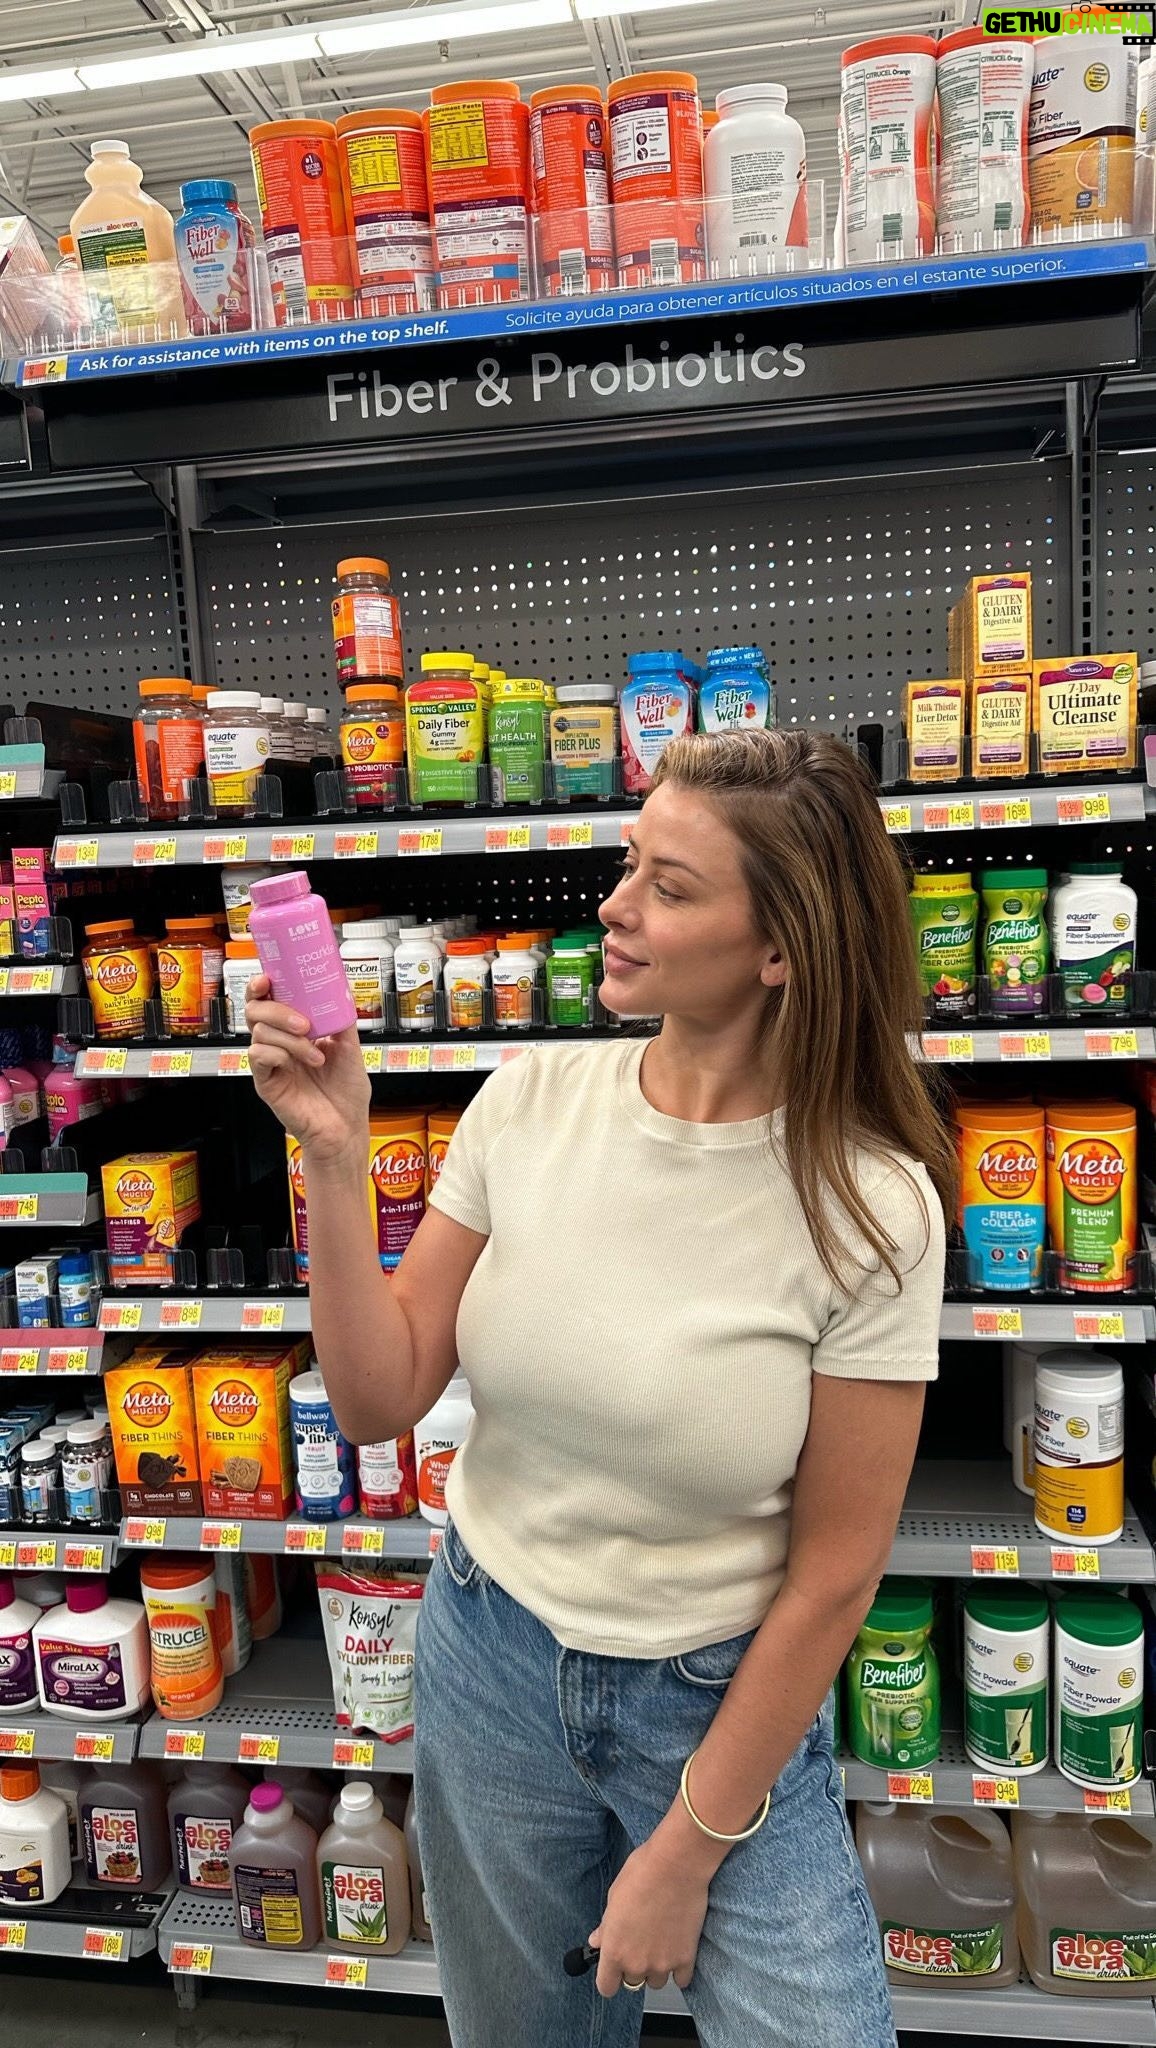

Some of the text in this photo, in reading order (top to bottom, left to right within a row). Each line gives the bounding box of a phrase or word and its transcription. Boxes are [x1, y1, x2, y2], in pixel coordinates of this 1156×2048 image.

[1039, 111, 1063, 124] Fiber
[106, 222, 122, 231] aloe
[121, 220, 138, 229] vera
[185, 224, 221, 246] Fiber
[187, 238, 215, 261] Well
[505, 256, 1067, 328] Solicite ayuda para obtener artículos situados en el estante superior.
[79, 319, 450, 371] Ask for assistance with items on the top shelf.
[327, 332, 807, 422] Fiber & Probiotics
[983, 594, 1023, 606] GLUTEN
[982, 605, 1022, 617] & DAIRY
[983, 616, 1023, 627] Digestive Aid
[1068, 682, 1101, 694] 7-Day
[635, 692, 673, 712] Fiber
[714, 689, 752, 709] Fiber
[981, 697, 1022, 708] GLUTEN
[1048, 692, 1122, 710] Ultimate
[448, 703, 475, 711] VALLEY
[714, 703, 743, 722] Well
[917, 702, 958, 712] Milk Thistle
[636, 707, 665, 725] Well
[916, 713, 957, 723] Liver Detox
[981, 708, 1022, 720] & DAIRY
[1052, 710, 1117, 726] Cleanse
[418, 718, 470, 731] Daily Fiber
[981, 719, 1009, 728] Digestive
[208, 733, 236, 743] equate
[431, 730, 456, 738] Gummy
[500, 732, 537, 741] HEALTH
[554, 738, 601, 751] FIBER PLUS
[14, 856, 39, 867] Pepto
[17, 895, 44, 905] Pepto
[1066, 913, 1098, 922] equate
[288, 920, 319, 937] LOVE
[987, 921, 1040, 945] Benefiber
[922, 927, 973, 950] Benefiber
[1084, 931, 1126, 940] Supplement
[296, 944, 335, 966] sparkle
[95, 963, 138, 980] Meta
[299, 963, 328, 978] fiber
[104, 976, 132, 986] MUCIL
[104, 997, 142, 1009] DAILY FIBER
[368, 1154, 426, 1175] Meta
[976, 1152, 1039, 1172] Meta
[1057, 1151, 1127, 1175] Meta
[381, 1174, 420, 1185] MUCIL
[988, 1173, 1030, 1183] MUCIL
[1069, 1176, 1115, 1187] MUCIL
[115, 1179, 156, 1192] Meta
[381, 1200, 423, 1214] 4-in-1 FIBER
[1071, 1207, 1114, 1217] PREMIUM
[989, 1210, 1020, 1219] FIBER
[1077, 1216, 1109, 1226] BLEND
[981, 1217, 1037, 1228] COLLAGEN
[122, 1392, 173, 1408] Meta
[209, 1391, 260, 1407] Meta
[131, 1407, 163, 1415] MUCIL
[219, 1406, 250, 1415] MUCIL
[297, 1412, 330, 1420] bellway
[294, 1422, 328, 1434] super
[120, 1431, 184, 1442] FIBER THINS
[206, 1431, 269, 1442] FIBER THINS
[309, 1431, 340, 1444] fiber
[1045, 1435, 1065, 1448] Fiber
[432, 1440, 454, 1448] now
[348, 1600, 394, 1638] Konsyl
[40, 1643, 83, 1655] Value Size
[344, 1635, 395, 1655] DAILY
[382, 1654, 414, 1665] FIBER
[1063, 1655, 1097, 1675] equate
[57, 1662, 100, 1673] MiraLAX
[861, 1662, 925, 1687] Benefiber
[983, 1673, 1018, 1687] Powder
[170, 1691, 195, 1701] orange
[876, 1691, 915, 1699] PREBIOTIC
[1063, 1683, 1122, 1705] Fiber Powder
[93, 1815, 136, 1832] aloe
[94, 1828, 137, 1844] vera
[186, 1824, 231, 1840] aloe
[116, 1840, 135, 1850] drink
[187, 1837, 231, 1851] vera
[335, 1873, 383, 1890] aloe
[335, 1888, 383, 1903] vera
[359, 1900, 381, 1910] drink
[887, 1929, 953, 1952] aloe
[1057, 1934, 1124, 1956] aloe
[887, 1943, 953, 1967] vera
[1057, 1950, 1124, 1970] vera
[925, 1962, 954, 1973] drink
[1096, 1967, 1127, 1978] drink
